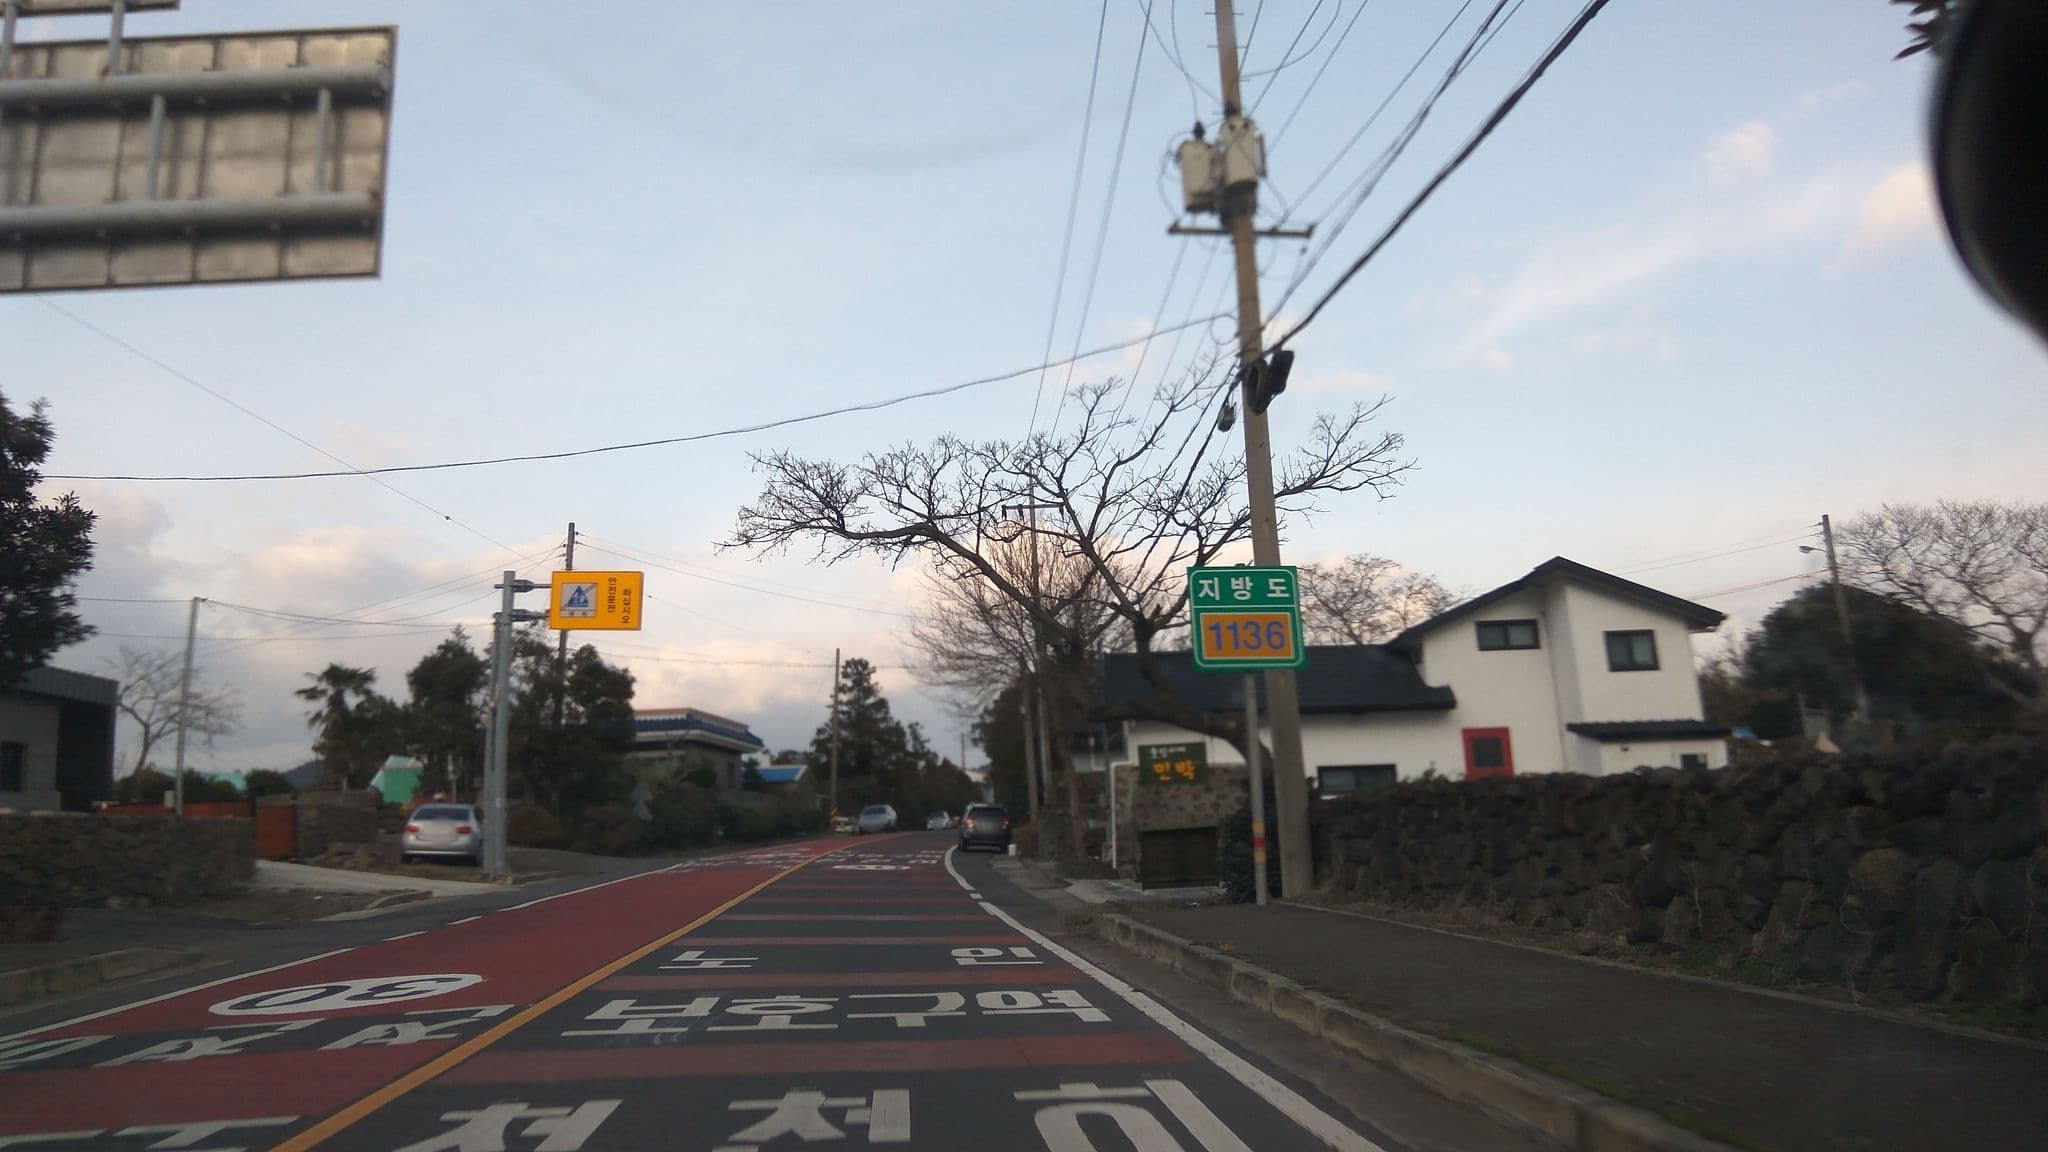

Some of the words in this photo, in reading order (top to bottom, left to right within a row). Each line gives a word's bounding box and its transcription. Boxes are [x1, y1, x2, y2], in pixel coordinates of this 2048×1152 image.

[1198, 576, 1290, 601] 지방도
[1208, 620, 1286, 651] 1136
[230, 977, 466, 1011] 30
[561, 990, 1112, 1036] 보호구역
